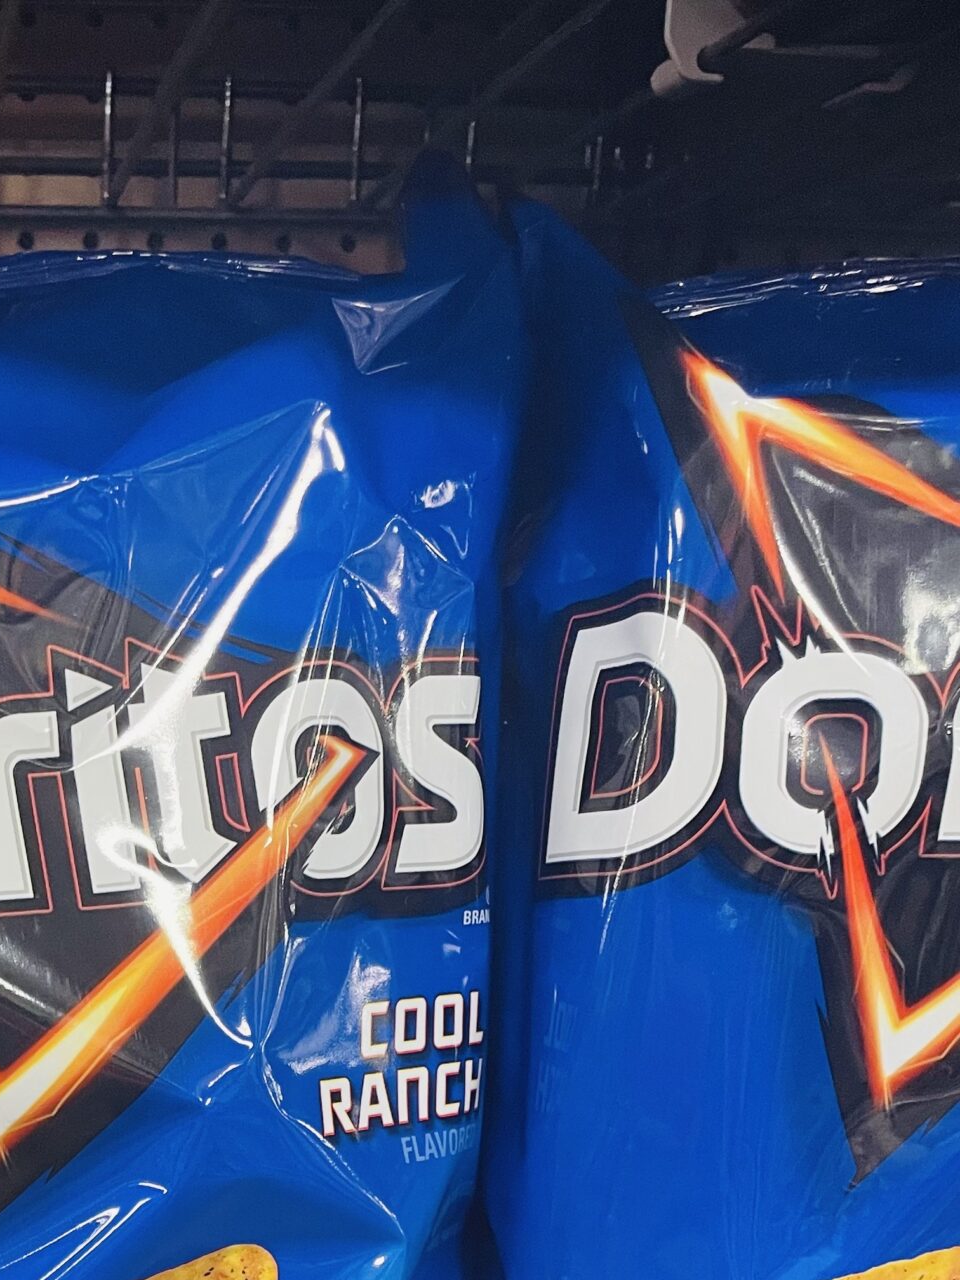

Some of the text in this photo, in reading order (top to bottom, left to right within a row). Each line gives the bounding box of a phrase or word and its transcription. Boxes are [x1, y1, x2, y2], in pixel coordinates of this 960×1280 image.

[463, 908, 490, 926] BRAN
[361, 991, 483, 1060] COOL
[319, 1057, 483, 1137] RANCH
